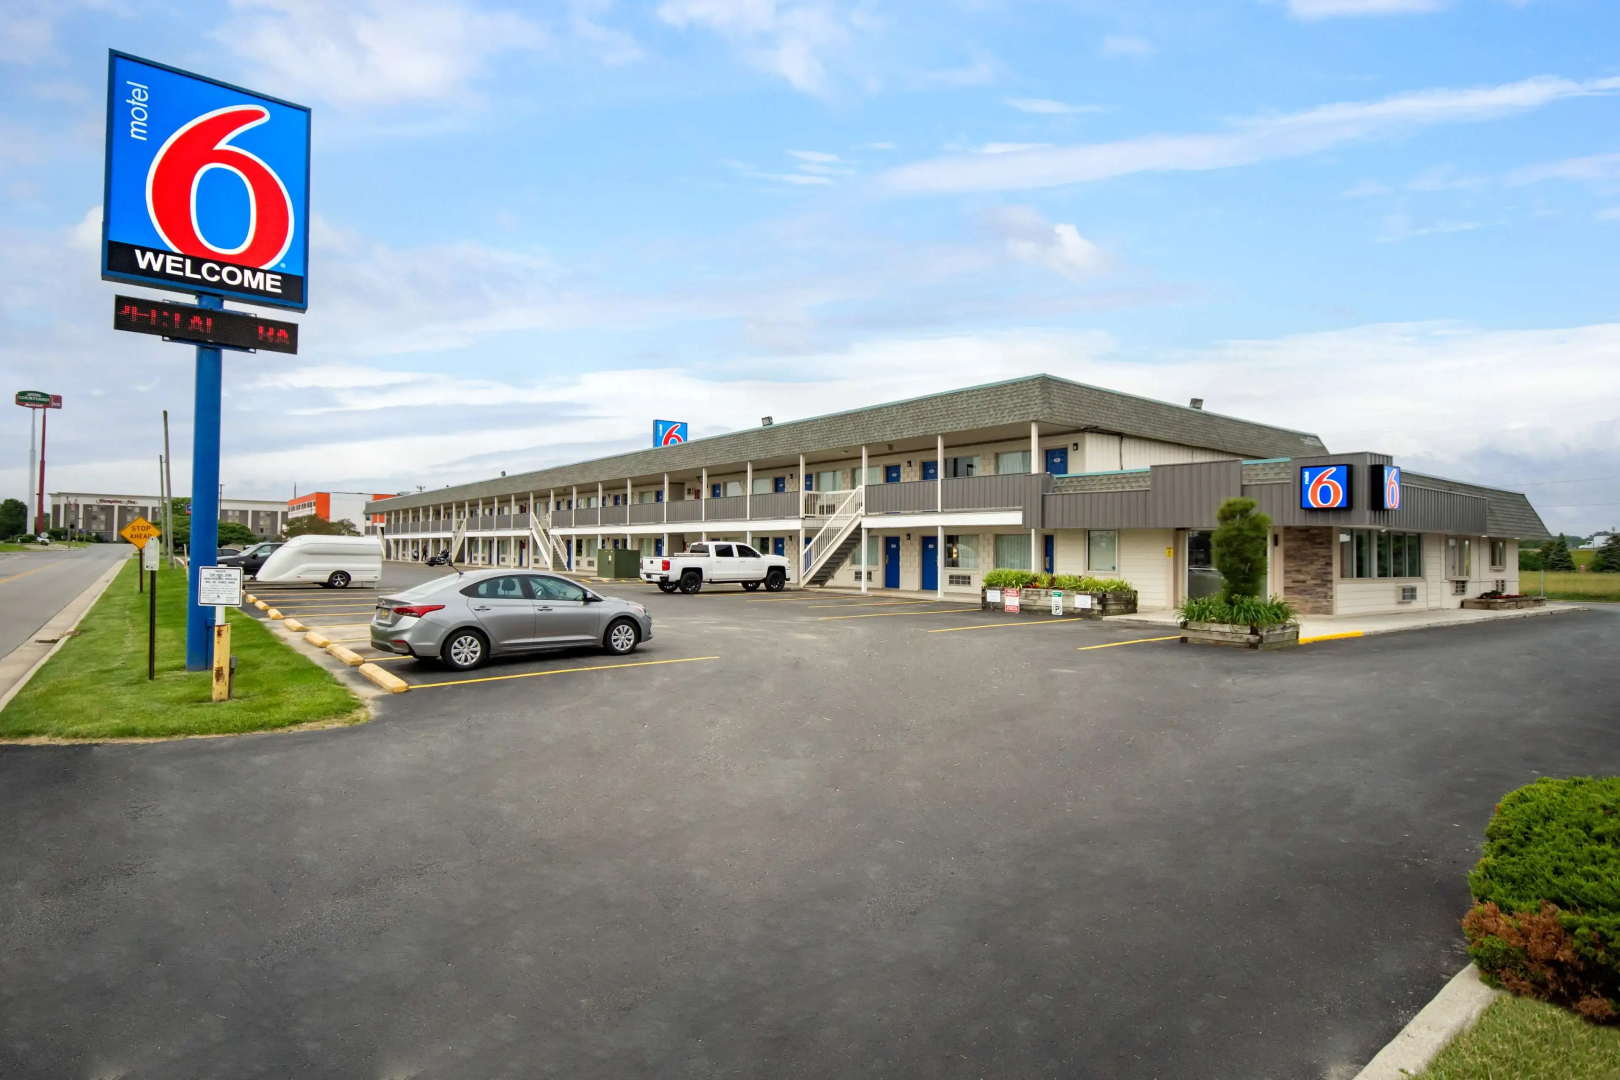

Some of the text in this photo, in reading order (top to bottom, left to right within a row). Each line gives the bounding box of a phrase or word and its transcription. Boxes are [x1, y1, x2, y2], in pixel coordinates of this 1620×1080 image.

[126, 81, 295, 270] motel 6
[135, 249, 282, 294] WELCOME
[1308, 467, 1343, 508] 6
[1387, 469, 1399, 508] 6
